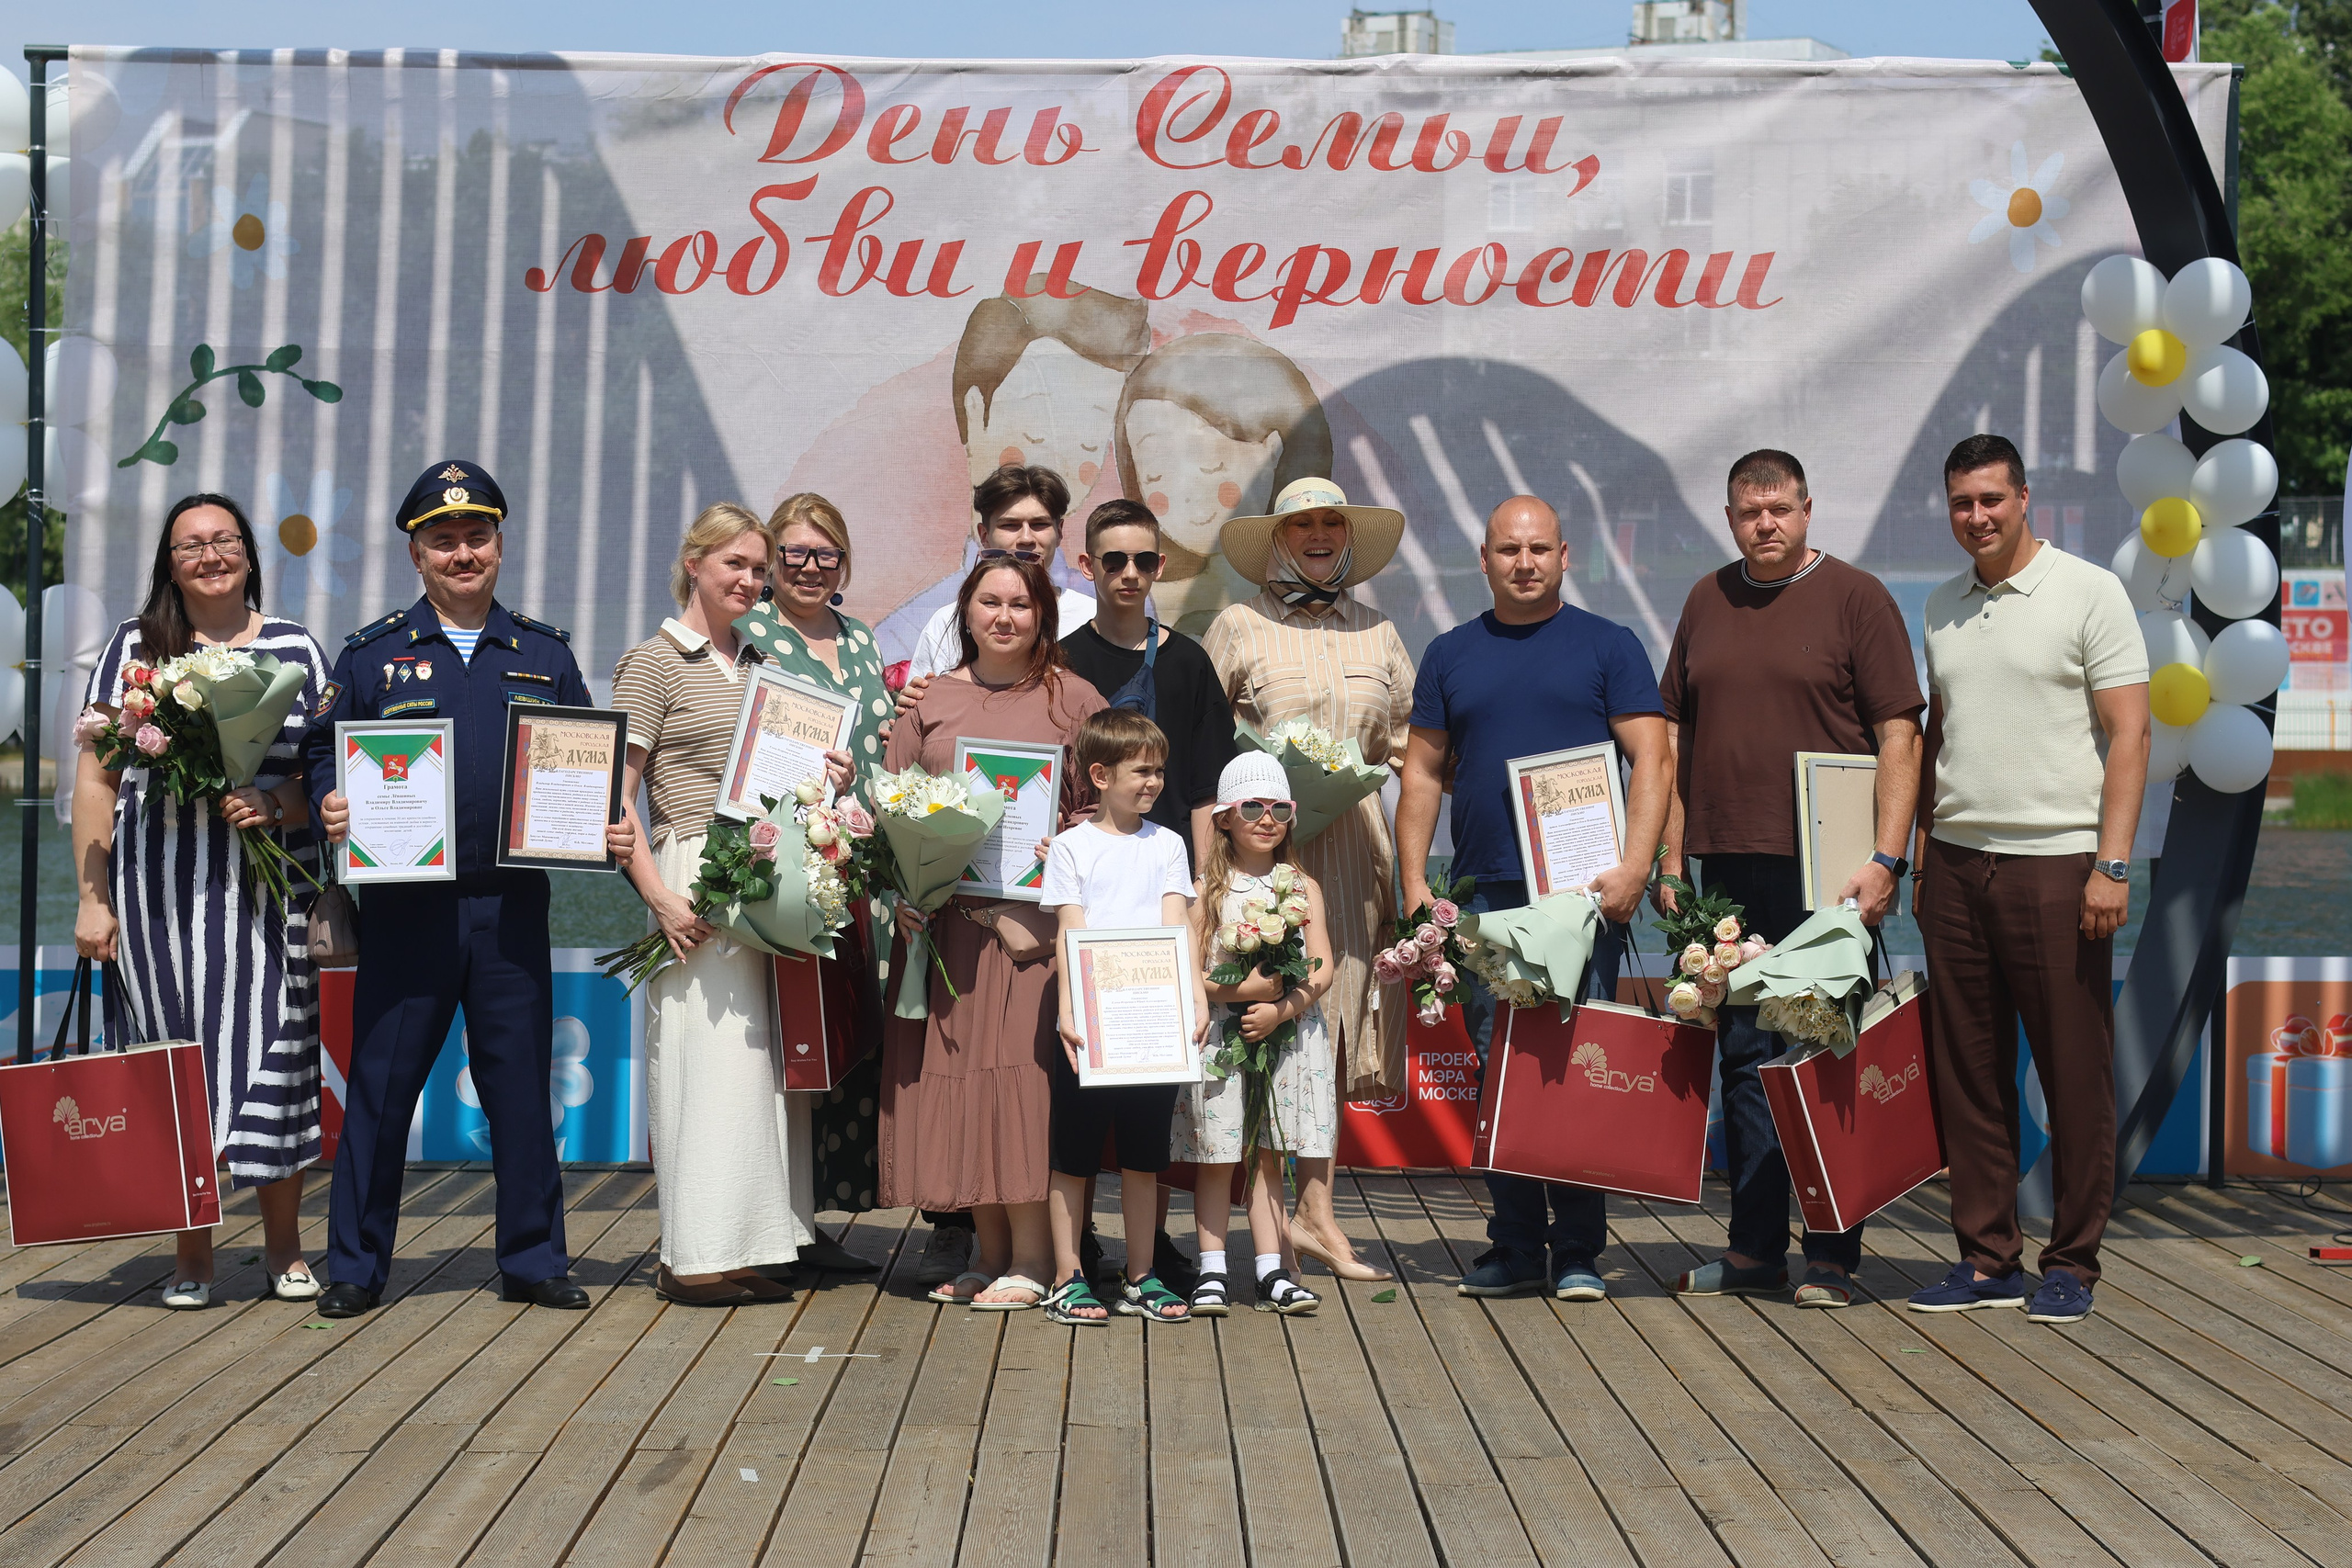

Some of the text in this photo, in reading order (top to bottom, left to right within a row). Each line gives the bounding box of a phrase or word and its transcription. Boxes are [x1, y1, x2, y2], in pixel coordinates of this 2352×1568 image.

[723, 62, 1600, 197] День Семьи,
[526, 175, 1783, 329] любви и верности
[2281, 616, 2335, 639] ЕТО
[791, 702, 836, 722] МОСКОВСКАЯ
[560, 731, 610, 740] МОСКОВСКАЯ
[793, 721, 830, 744] ДУМА
[566, 749, 608, 766] ДУМА
[1557, 766, 1601, 780] МОСКОВСКАЯ
[1568, 784, 1605, 805] ДУМА
[1121, 950, 1170, 958] МОСКОВСКАЯ
[1132, 966, 1173, 984] ДУМА
[1419, 1069, 1466, 1083] МЭРА
[1589, 1067, 1655, 1093] arya
[1877, 1062, 1920, 1100] arya
[1419, 1087, 1477, 1100] МОСКВ
[69, 1114, 126, 1138] arya
